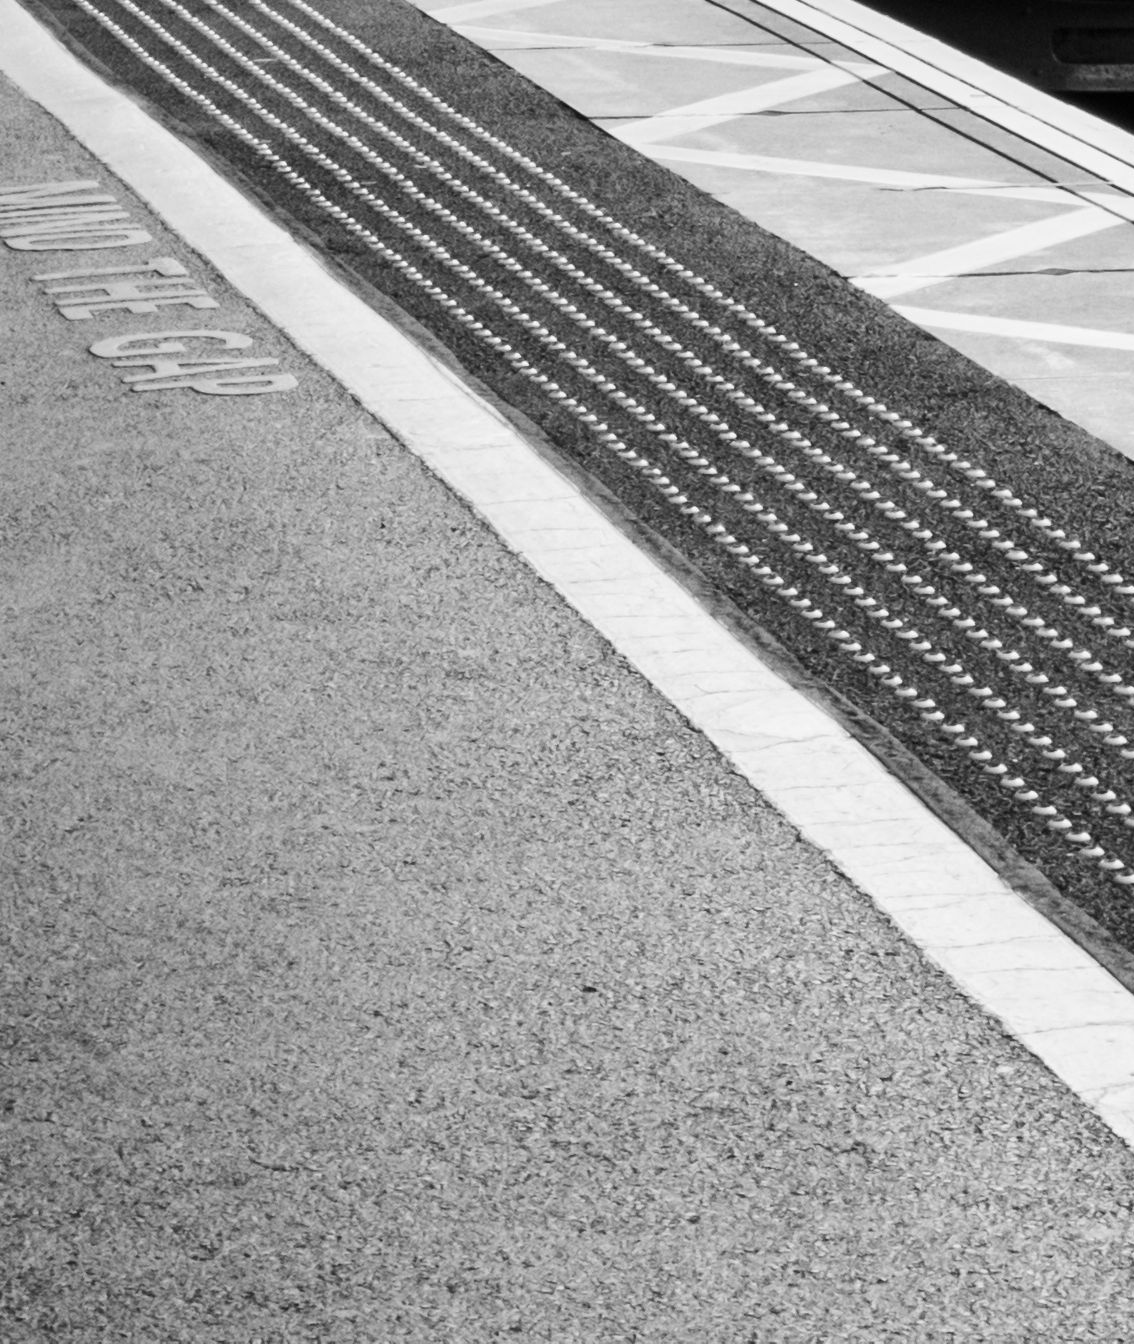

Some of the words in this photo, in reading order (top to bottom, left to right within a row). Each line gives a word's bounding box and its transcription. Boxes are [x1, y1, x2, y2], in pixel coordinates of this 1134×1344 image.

[0, 180, 152, 251] MIND
[31, 257, 220, 321] THE
[89, 329, 299, 396] GAP
